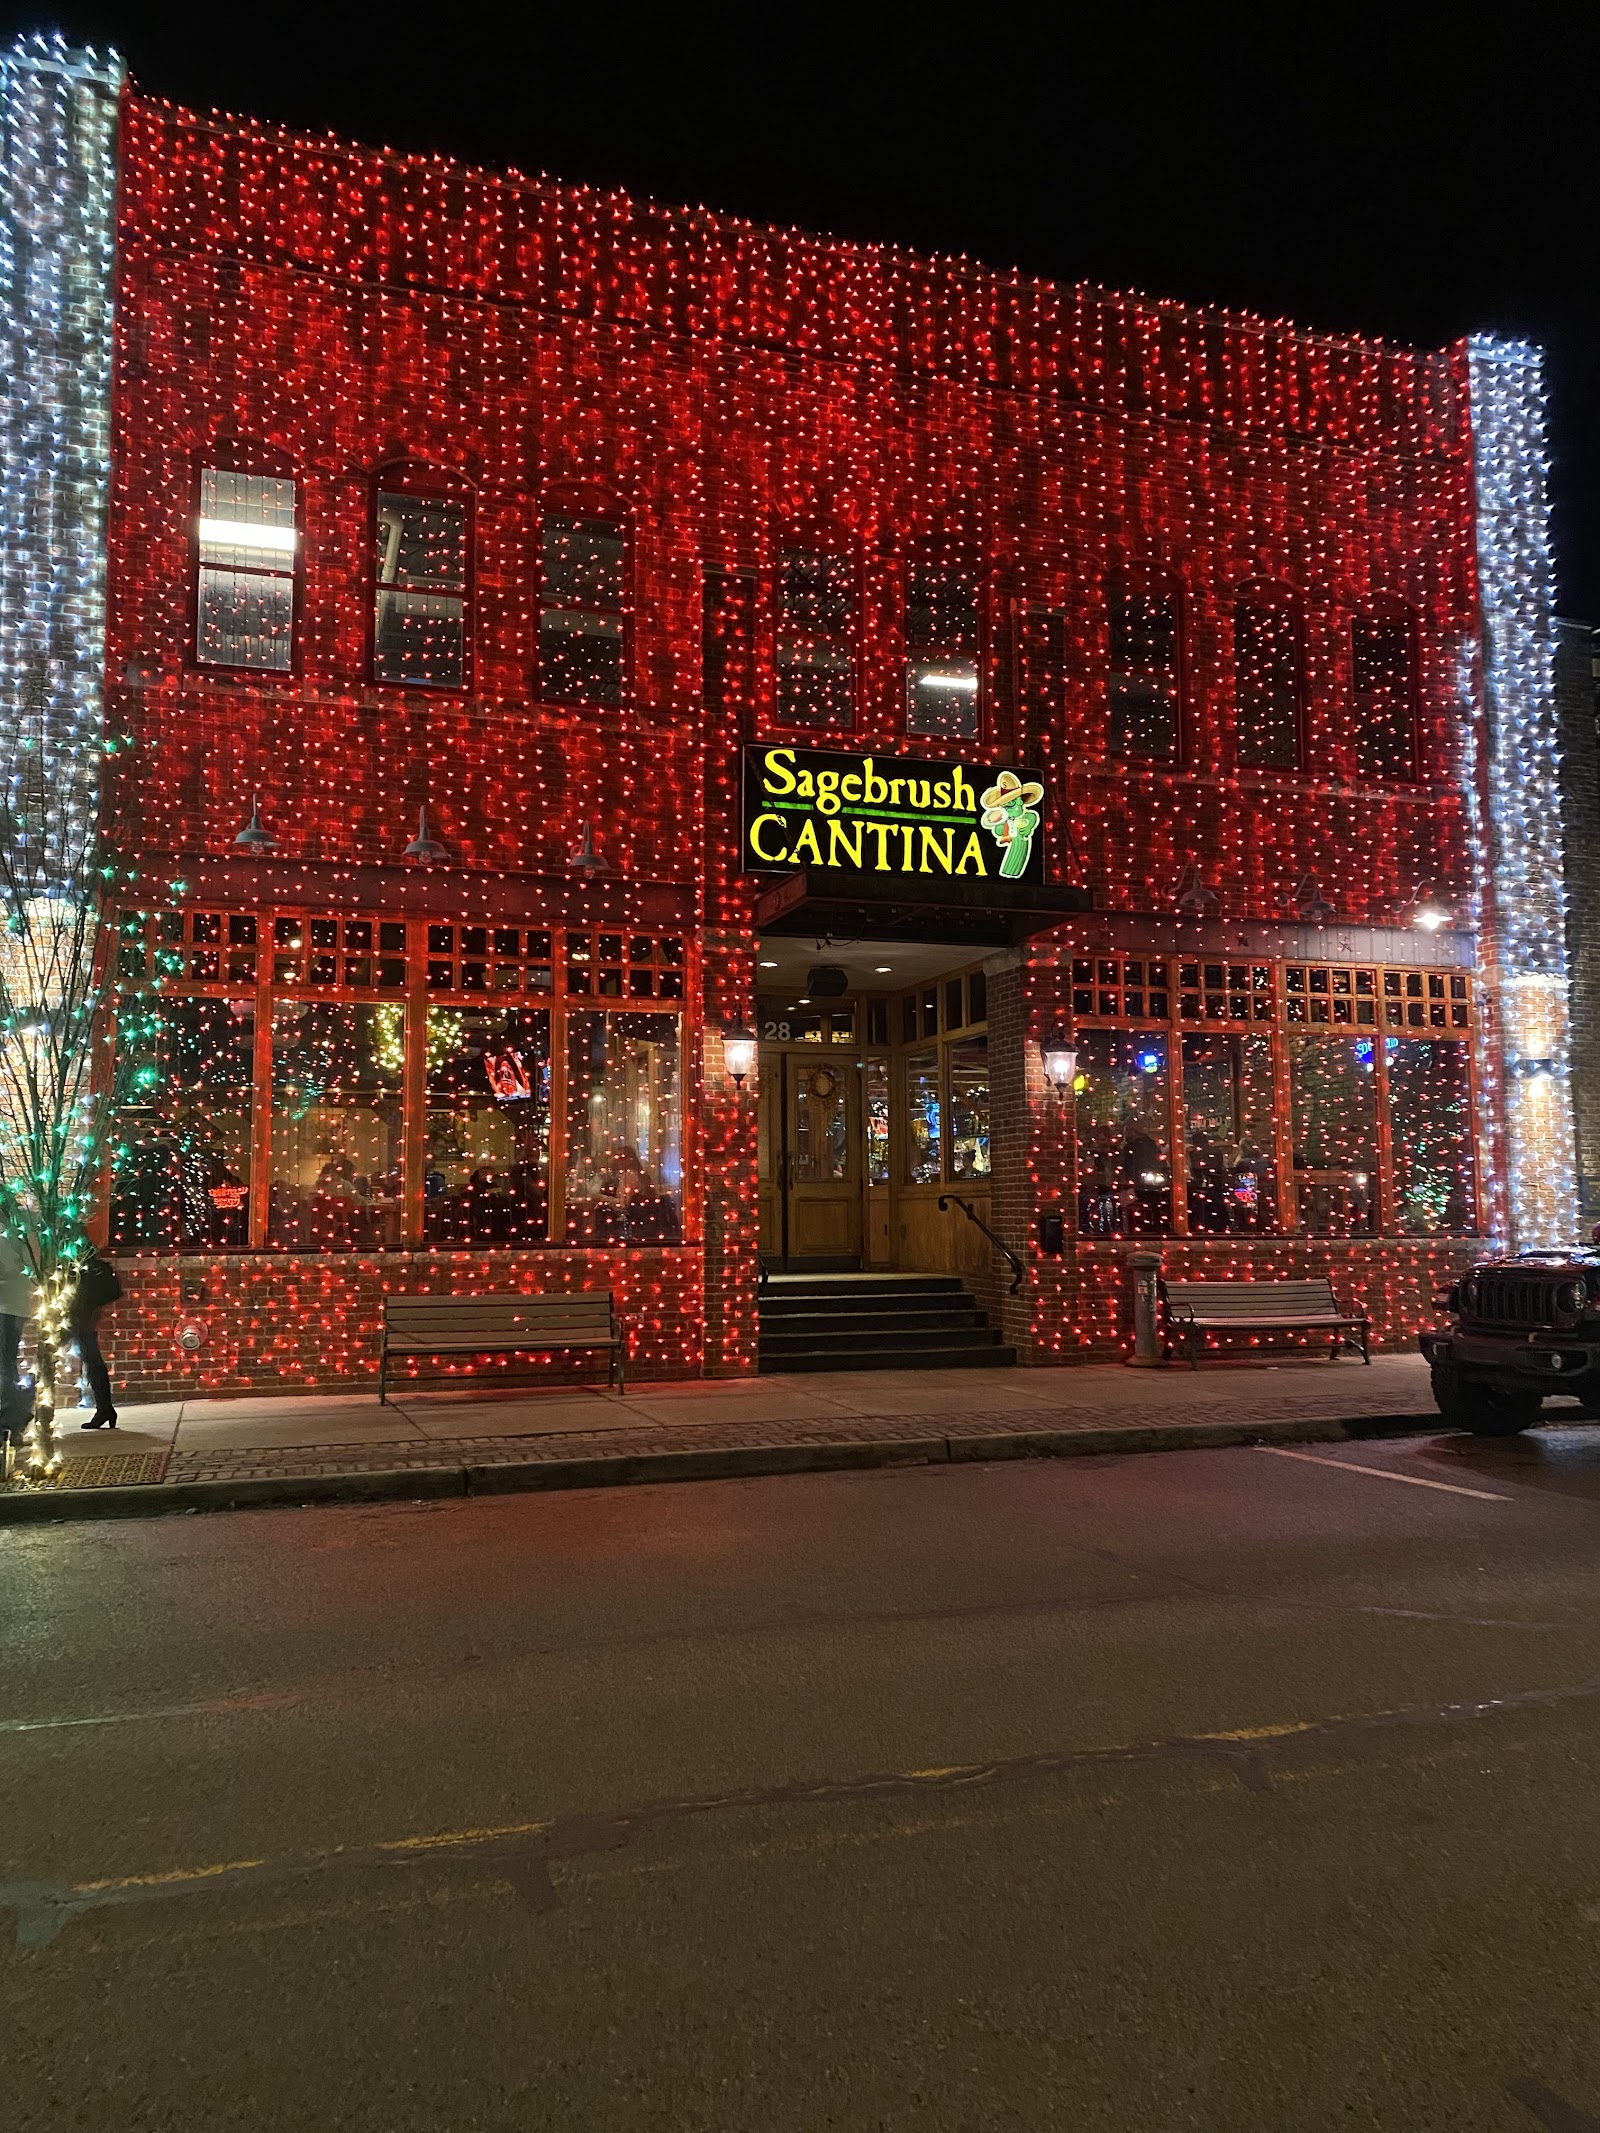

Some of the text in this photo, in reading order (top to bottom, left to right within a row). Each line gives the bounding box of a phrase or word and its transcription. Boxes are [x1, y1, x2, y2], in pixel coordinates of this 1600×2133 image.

[763, 749, 977, 815] Sagebrush
[750, 814, 988, 876] CANTINA
[764, 1021, 791, 1041] 28
